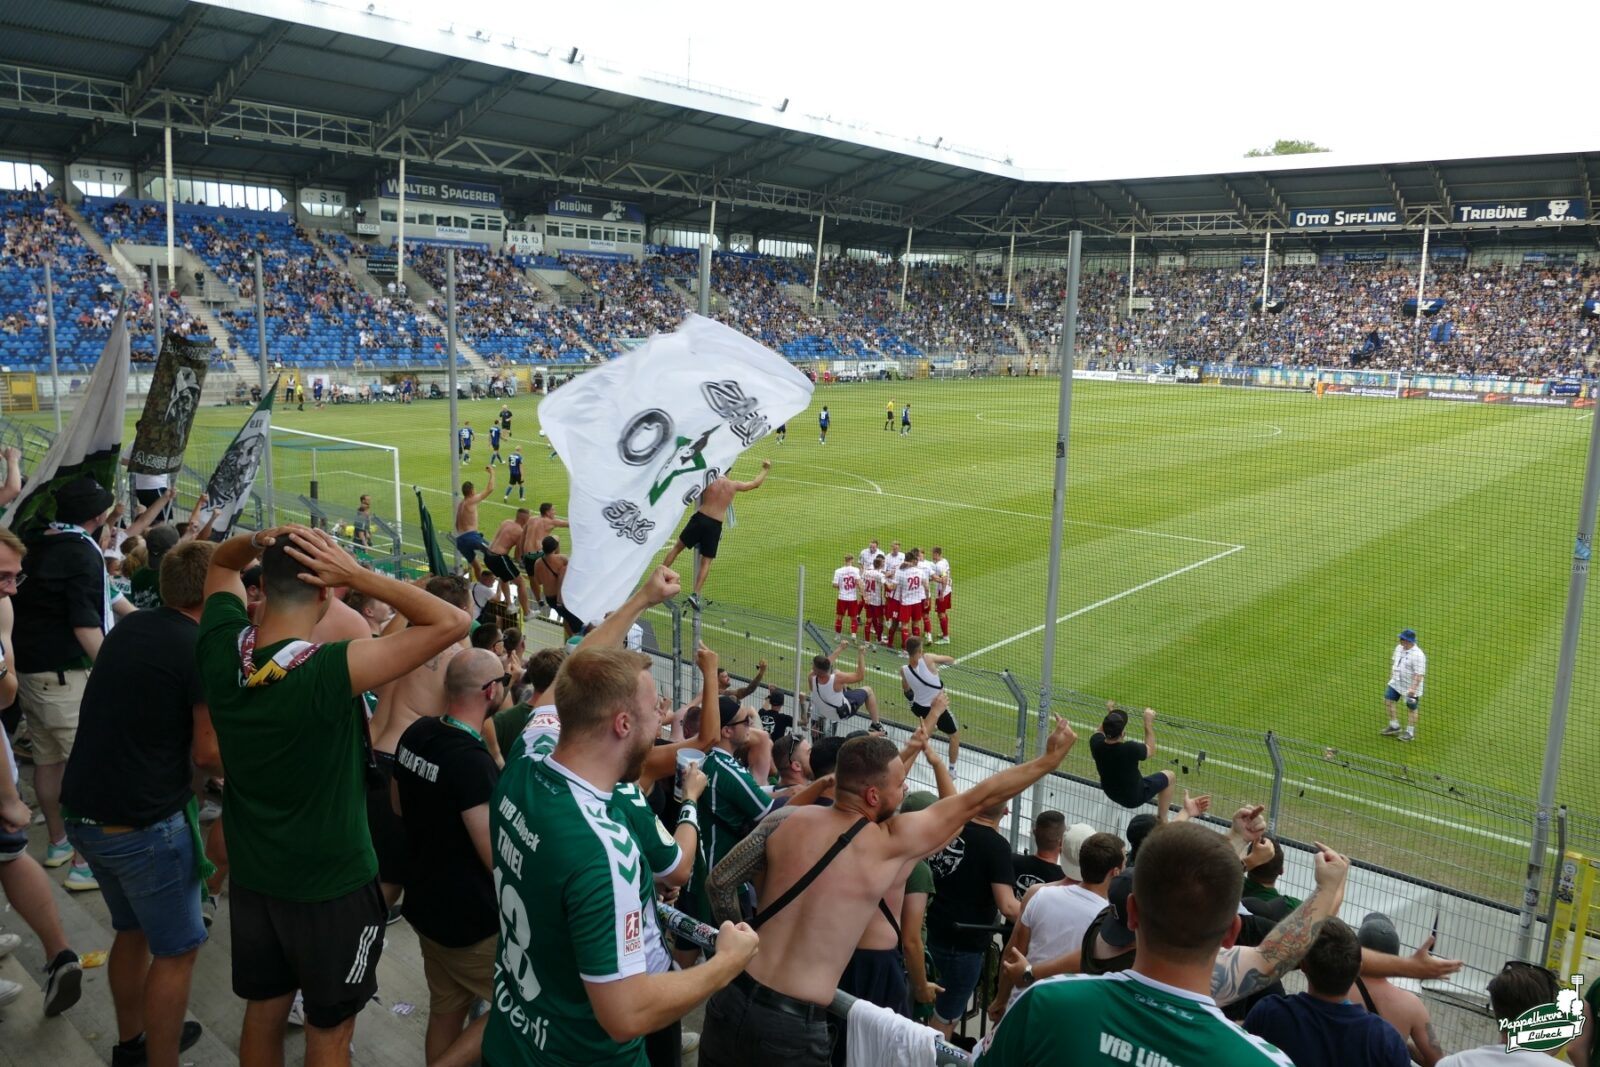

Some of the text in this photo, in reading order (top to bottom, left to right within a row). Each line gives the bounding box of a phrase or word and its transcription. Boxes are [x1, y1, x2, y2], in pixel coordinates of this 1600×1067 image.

[76, 168, 123, 182] 18 T 17
[320, 192, 328, 203] S
[521, 234, 528, 244] R
[843, 576, 855, 591] 33
[865, 580, 876, 592] 24
[907, 576, 920, 591] 29
[497, 825, 523, 880] THIEL
[1100, 1031, 1133, 1062] VfB
